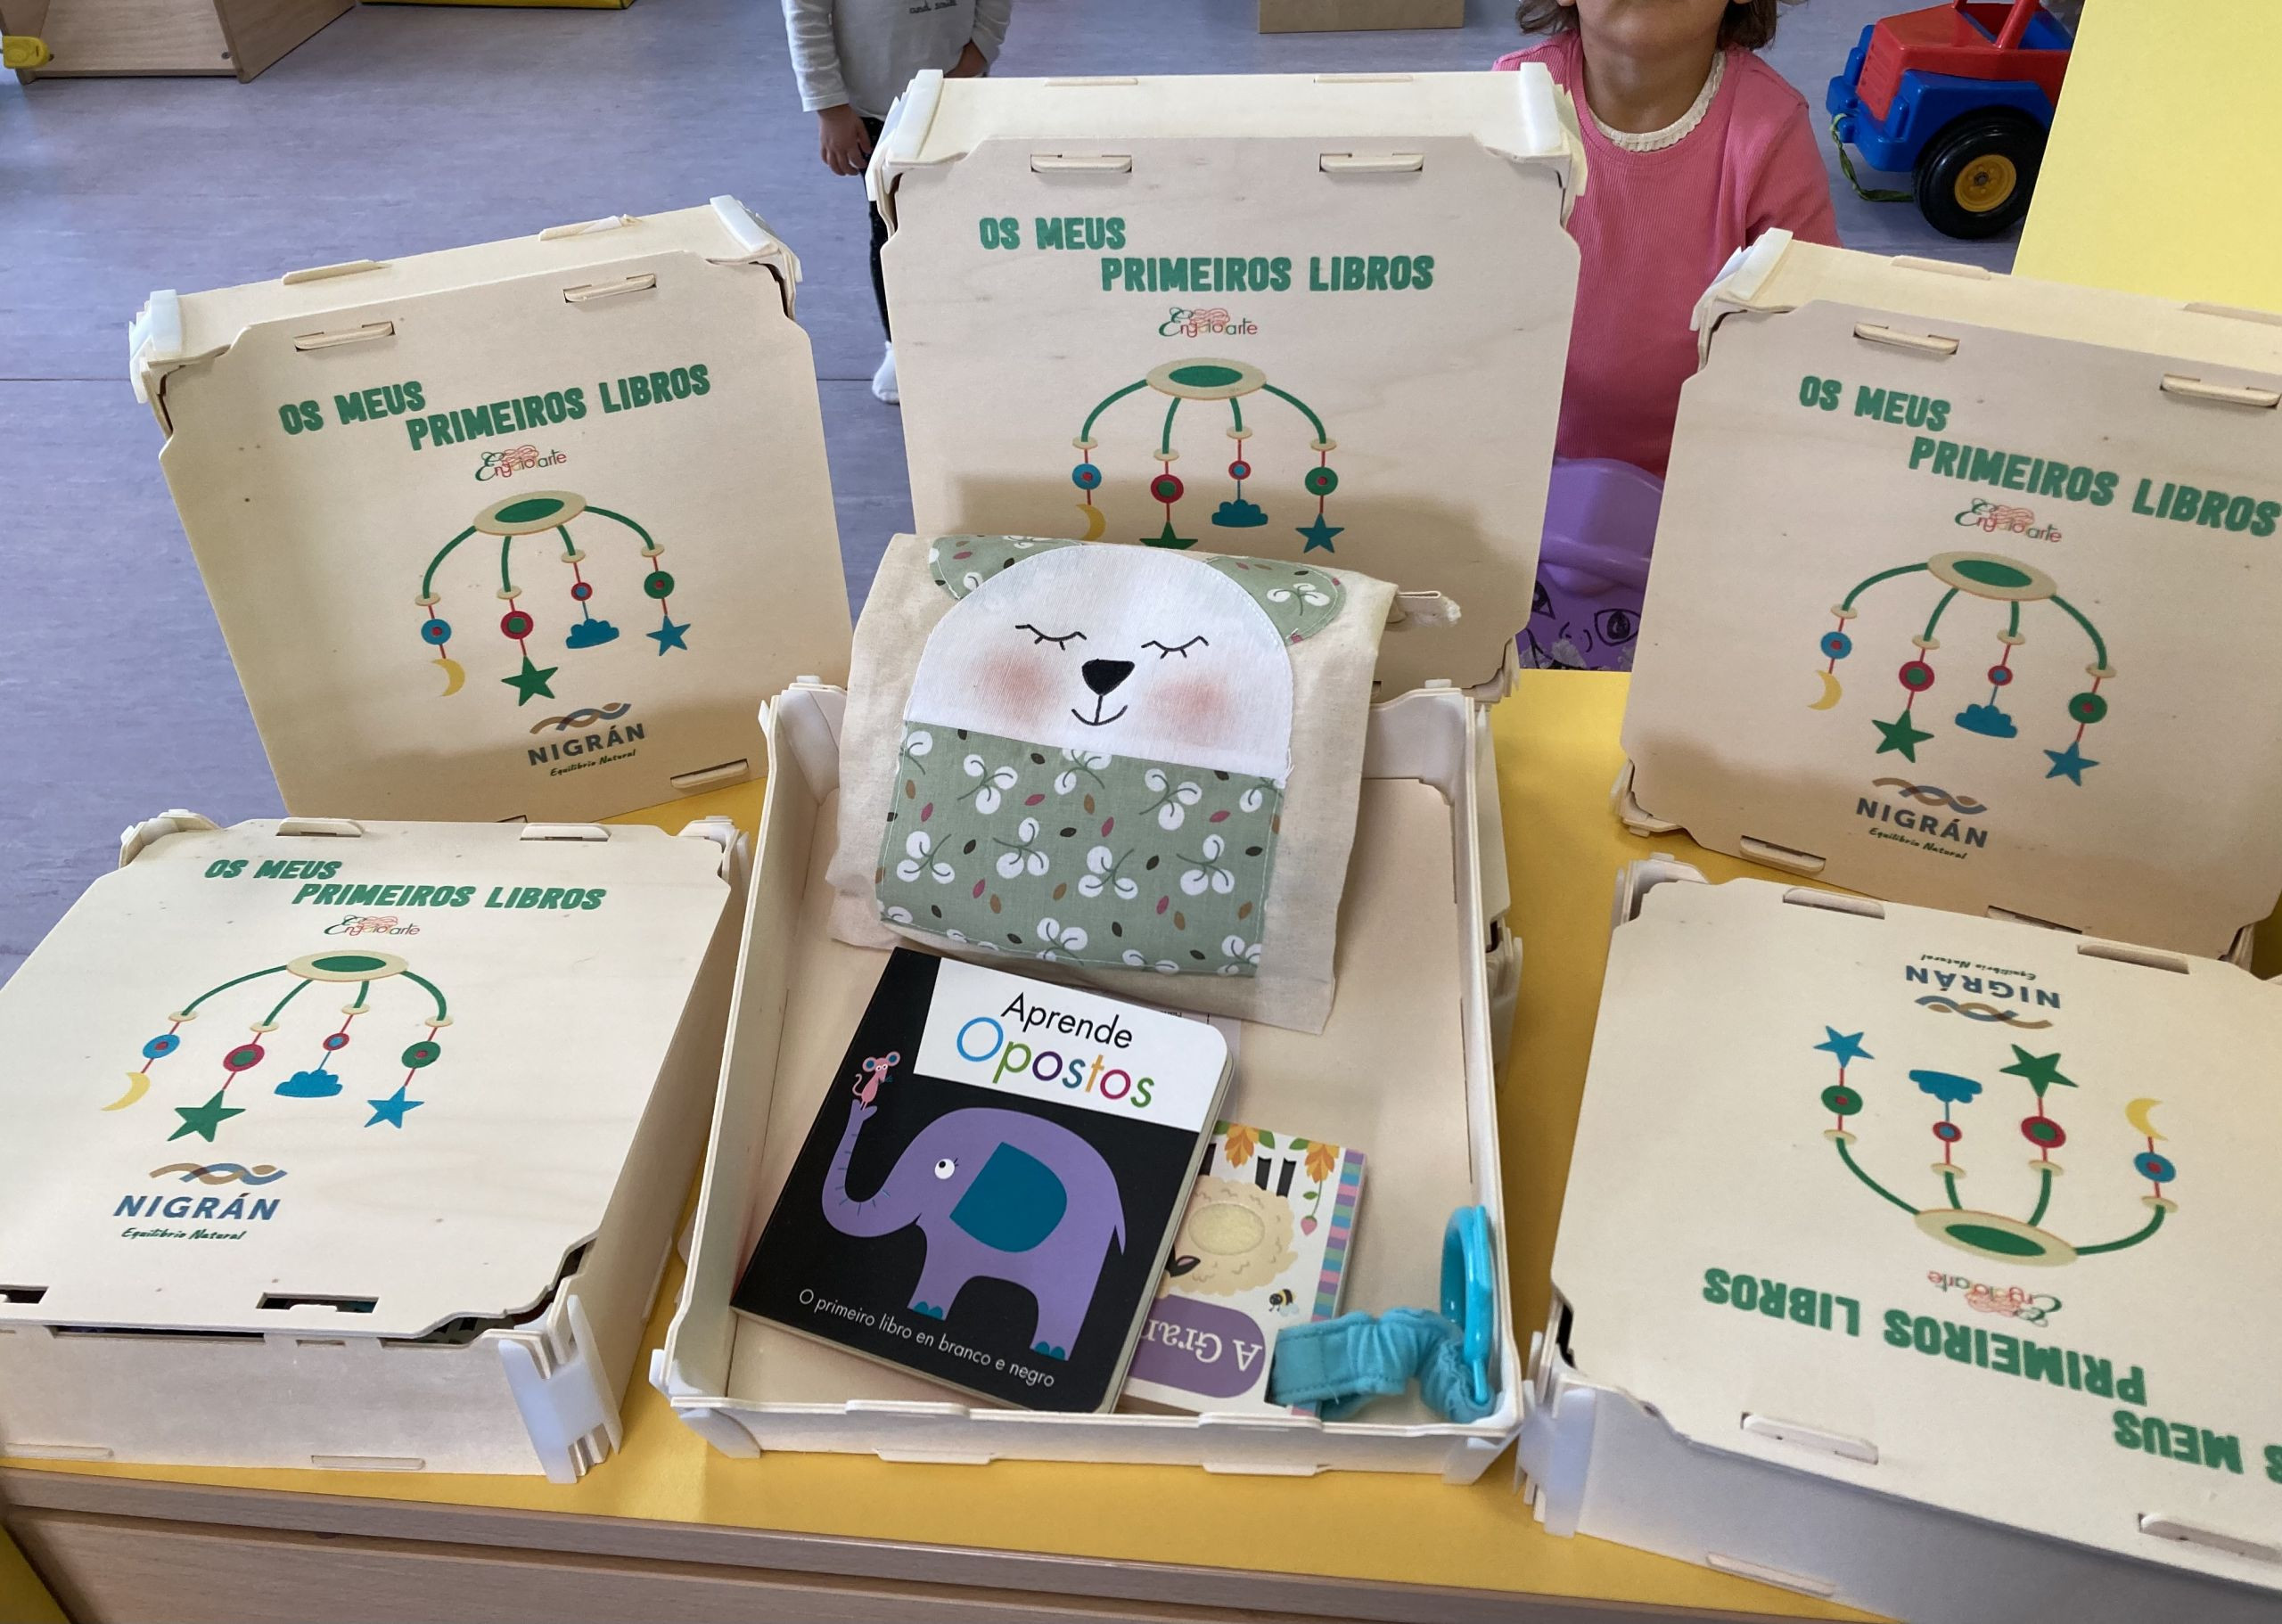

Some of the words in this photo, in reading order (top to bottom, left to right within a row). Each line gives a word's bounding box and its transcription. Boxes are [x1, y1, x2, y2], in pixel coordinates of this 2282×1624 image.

[980, 217, 1020, 250] OS
[1036, 217, 1126, 250] MEUS
[1101, 257, 1292, 291] PRIMEIROS
[1309, 255, 1435, 291] LIBROS
[278, 399, 324, 435] OS
[333, 381, 426, 425] MEUS
[406, 387, 587, 451] PRIMEIROS
[598, 364, 711, 414] LIBROS
[1799, 375, 1843, 412] OS
[1854, 385, 1951, 432] MEUS
[1909, 436, 2120, 506] PRIMEIROS
[2131, 478, 2282, 537] LIBROS
[527, 723, 645, 766] NIGRÁN
[550, 762, 596, 776] Equilibrio
[599, 749, 636, 764] Natural
[1855, 797, 1989, 848] NIGRÁN
[1868, 827, 1920, 847] Equilibrio
[1922, 842, 1968, 860] Natural
[204, 859, 247, 879] OS
[253, 860, 342, 880] MEUS
[291, 883, 476, 907] PRIMEIROS
[484, 886, 607, 910] LIBROS
[1905, 965, 2062, 1009] NIGRÁN
[1000, 991, 1133, 1048] Aprende
[956, 1016, 1155, 1108] Opostos
[112, 1192, 281, 1221] NIGRÁN
[121, 1227, 186, 1240] Equilibrio
[188, 1229, 248, 1240] Natural
[1702, 1267, 1860, 1338] LIBROS
[799, 1289, 815, 1305] O
[814, 1296, 875, 1326] primeiro
[878, 1313, 913, 1340] libro
[915, 1332, 935, 1348] en
[938, 1333, 991, 1366] branco
[995, 1358, 1006, 1371] e
[1009, 1362, 1055, 1388] negro
[1232, 1339, 1264, 1373] A
[1884, 1308, 2148, 1407] PRIMEIROS
[2113, 1409, 2245, 1475] MEUS
[2263, 1443, 2282, 1486] S
